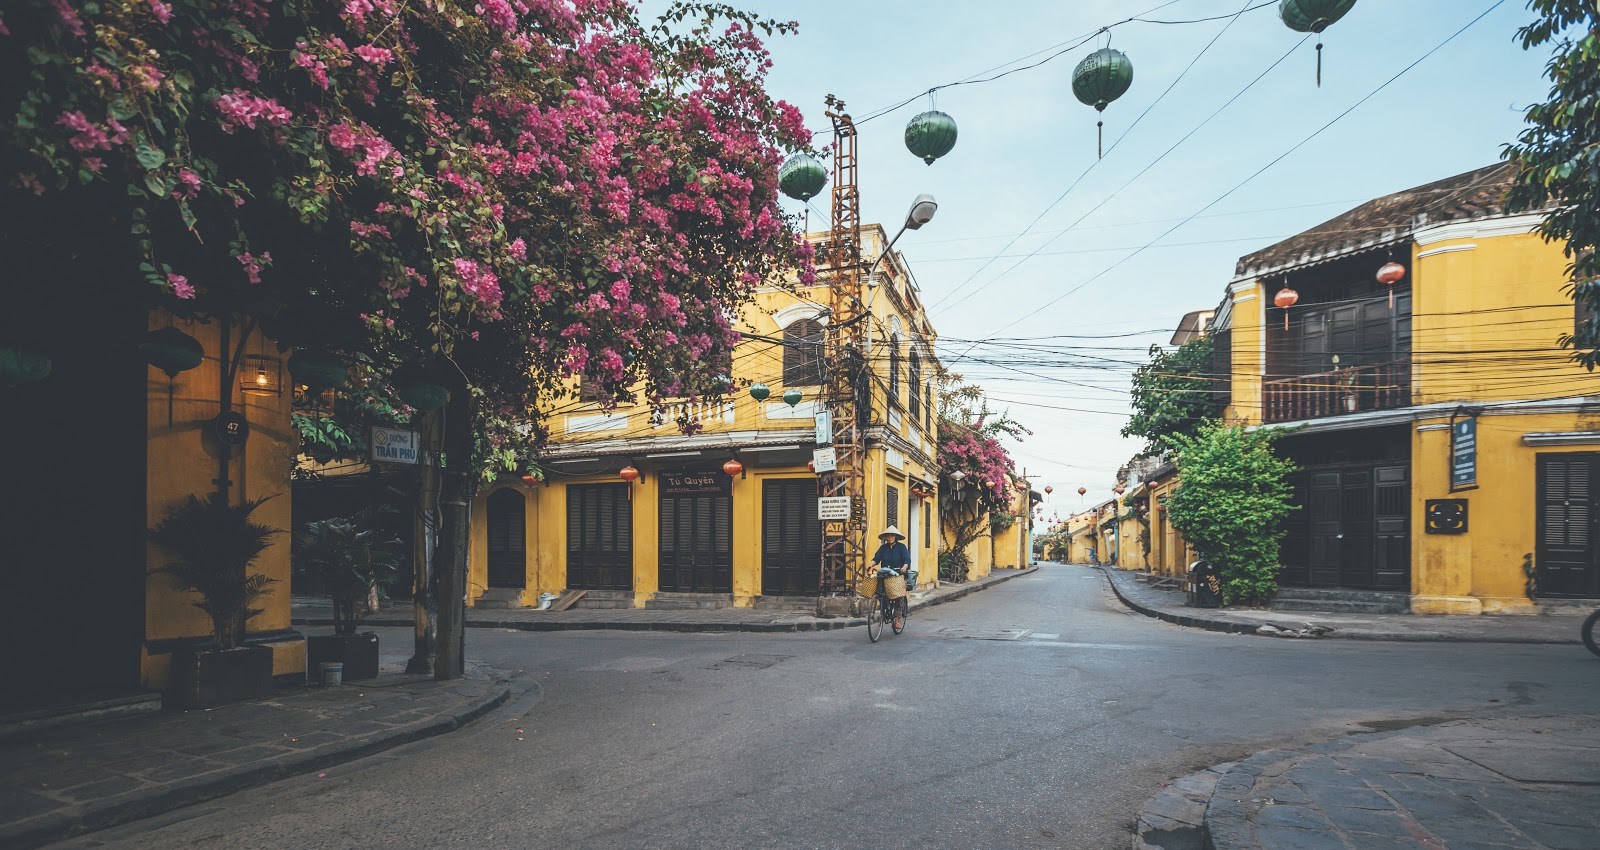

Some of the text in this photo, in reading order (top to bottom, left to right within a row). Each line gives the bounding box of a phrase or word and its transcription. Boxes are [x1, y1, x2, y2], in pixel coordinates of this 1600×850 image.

[227, 422, 239, 431] 47
[684, 476, 715, 486] Quyên
[825, 522, 850, 532] ATM
